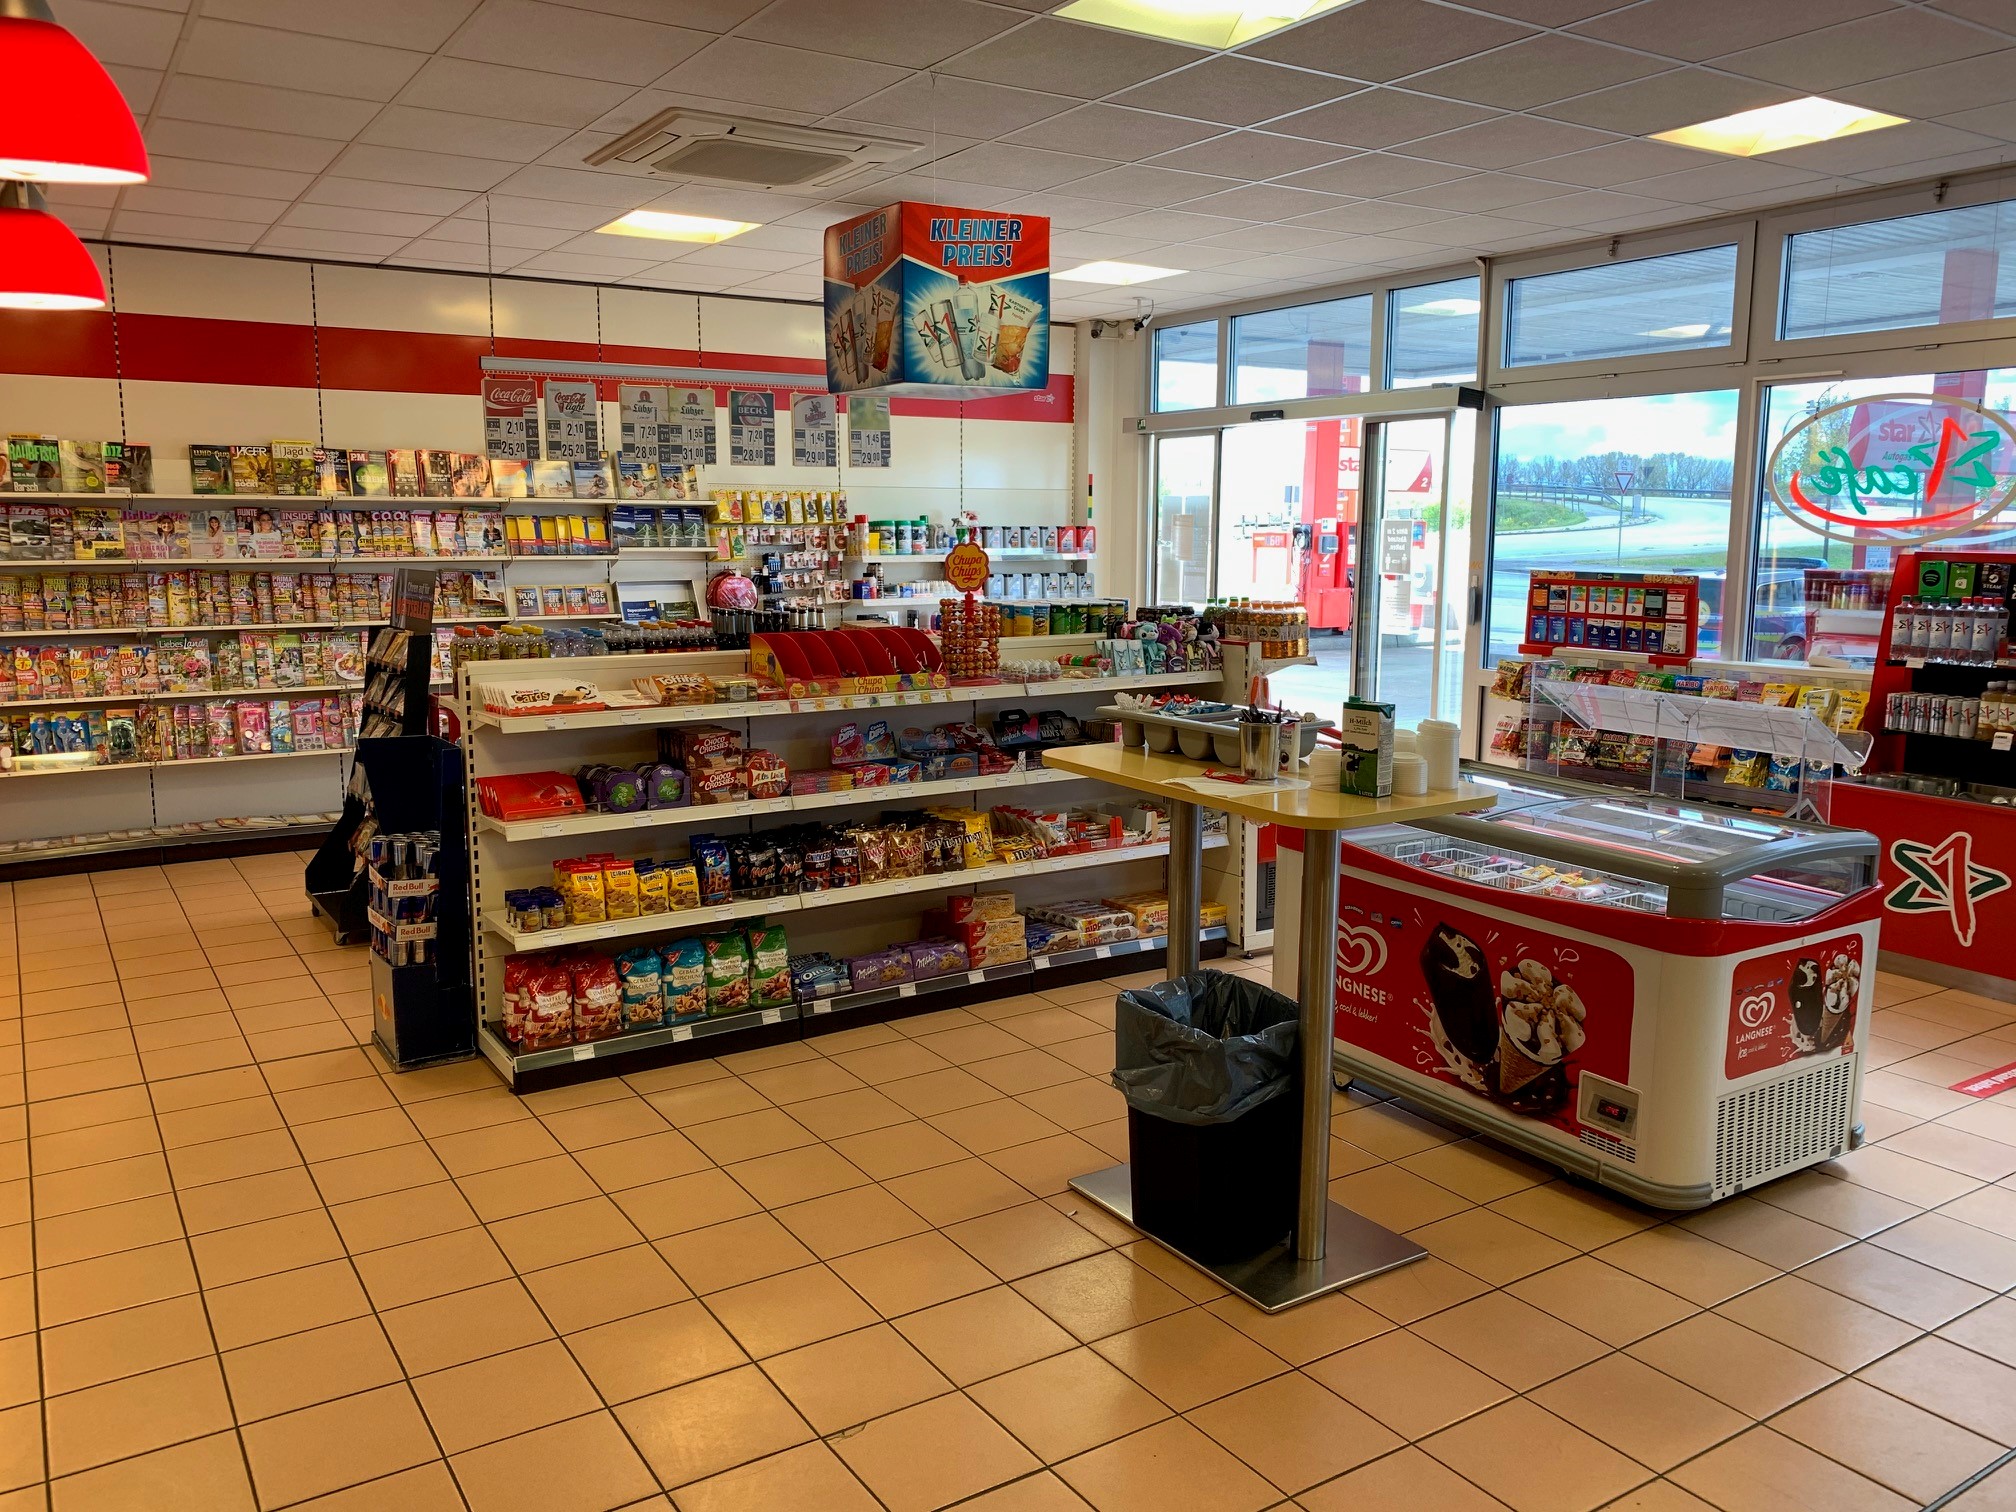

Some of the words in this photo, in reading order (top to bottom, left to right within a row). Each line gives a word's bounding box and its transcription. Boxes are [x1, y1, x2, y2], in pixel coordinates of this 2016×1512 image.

[839, 213, 887, 257] KLEINER
[929, 218, 1023, 242] KLEINER
[846, 240, 883, 278] PREIS!
[942, 244, 1013, 268] PREIS!
[490, 388, 533, 403] Coca-Cola
[554, 392, 586, 405] Coca-Cola
[680, 406, 705, 416] Lübzer
[507, 421, 524, 434] 2.10
[567, 424, 584, 437] 2.10
[1879, 419, 1915, 442] star
[688, 428, 703, 441] 1.55
[748, 428, 763, 442] 7.20
[811, 432, 825, 445] 1.45
[866, 433, 880, 446] 1.45
[283, 446, 304, 458] Jagd
[501, 441, 525, 456] 25.20
[562, 444, 585, 457] 25.20
[683, 448, 704, 460] 31.00
[350, 452, 369, 461] P.M.
[806, 451, 826, 463] 29.00
[862, 452, 880, 464] 29.00
[14, 482, 39, 492] Barsch
[1421, 477, 1429, 488] 2
[282, 511, 314, 521] INSIDE
[953, 555, 982, 567] Chupa
[952, 565, 982, 583] Chups
[590, 591, 606, 599] USE
[159, 640, 183, 649] Liebes
[1499, 664, 1518, 675] HARIBO
[656, 675, 705, 686] Toffifee
[857, 677, 883, 686] Chupa
[1611, 674, 1635, 686] HARIBO
[1676, 680, 1700, 689] HARIBO
[857, 685, 884, 693] Chups
[1704, 684, 1730, 693] HARIBO
[1349, 718, 1372, 726] H-Milch
[838, 729, 856, 744] DIPS
[868, 727, 887, 742] DIPS
[1571, 728, 1595, 738] HARIBO
[1603, 733, 1628, 743] HARIBO
[703, 736, 726, 747] CHOCO
[709, 771, 731, 782] CHOCO
[863, 771, 877, 782] DIPS
[897, 768, 911, 778] DIPS
[805, 851, 832, 862] SNICKERS
[834, 847, 859, 858] SNICKERS
[610, 870, 631, 878] LEIBNIZ
[643, 873, 663, 883] LEIBNIZ
[674, 868, 693, 877] LEIBNIZ
[577, 875, 598, 883] LEIBNIZ
[1145, 911, 1160, 919] soft
[401, 928, 416, 936] Red
[416, 926, 431, 934] Bull
[915, 954, 936, 969] Milka
[855, 964, 878, 980] Milka
[1736, 1025, 1774, 1044] LANGNESE
